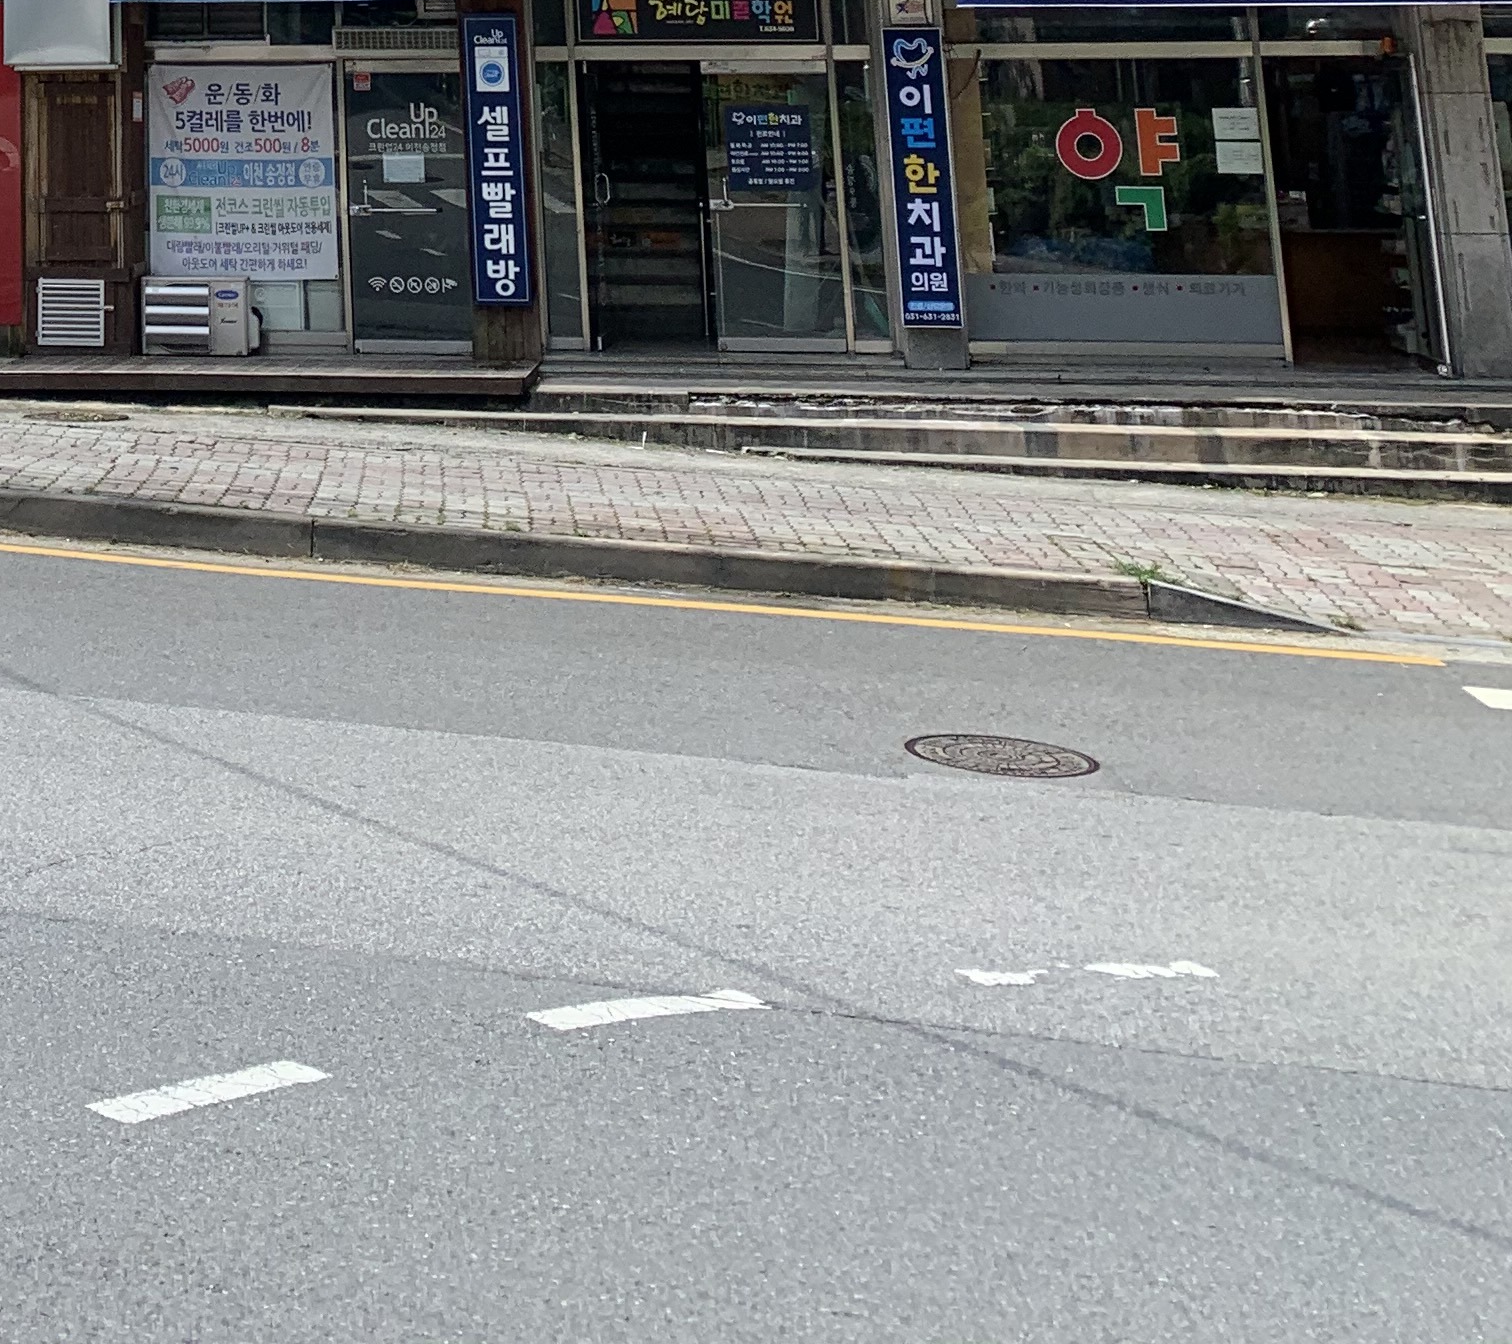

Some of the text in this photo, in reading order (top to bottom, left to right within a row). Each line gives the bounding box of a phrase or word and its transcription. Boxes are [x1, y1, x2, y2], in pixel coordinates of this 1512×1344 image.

[204, 82, 282, 106] 운/동/화
[175, 110, 313, 133] 5켤레를 한번에!
[366, 118, 425, 139] Clean
[1055, 108, 1181, 232] 약
[476, 104, 521, 297] 셀프빨래방
[910, 271, 949, 293] 의원
